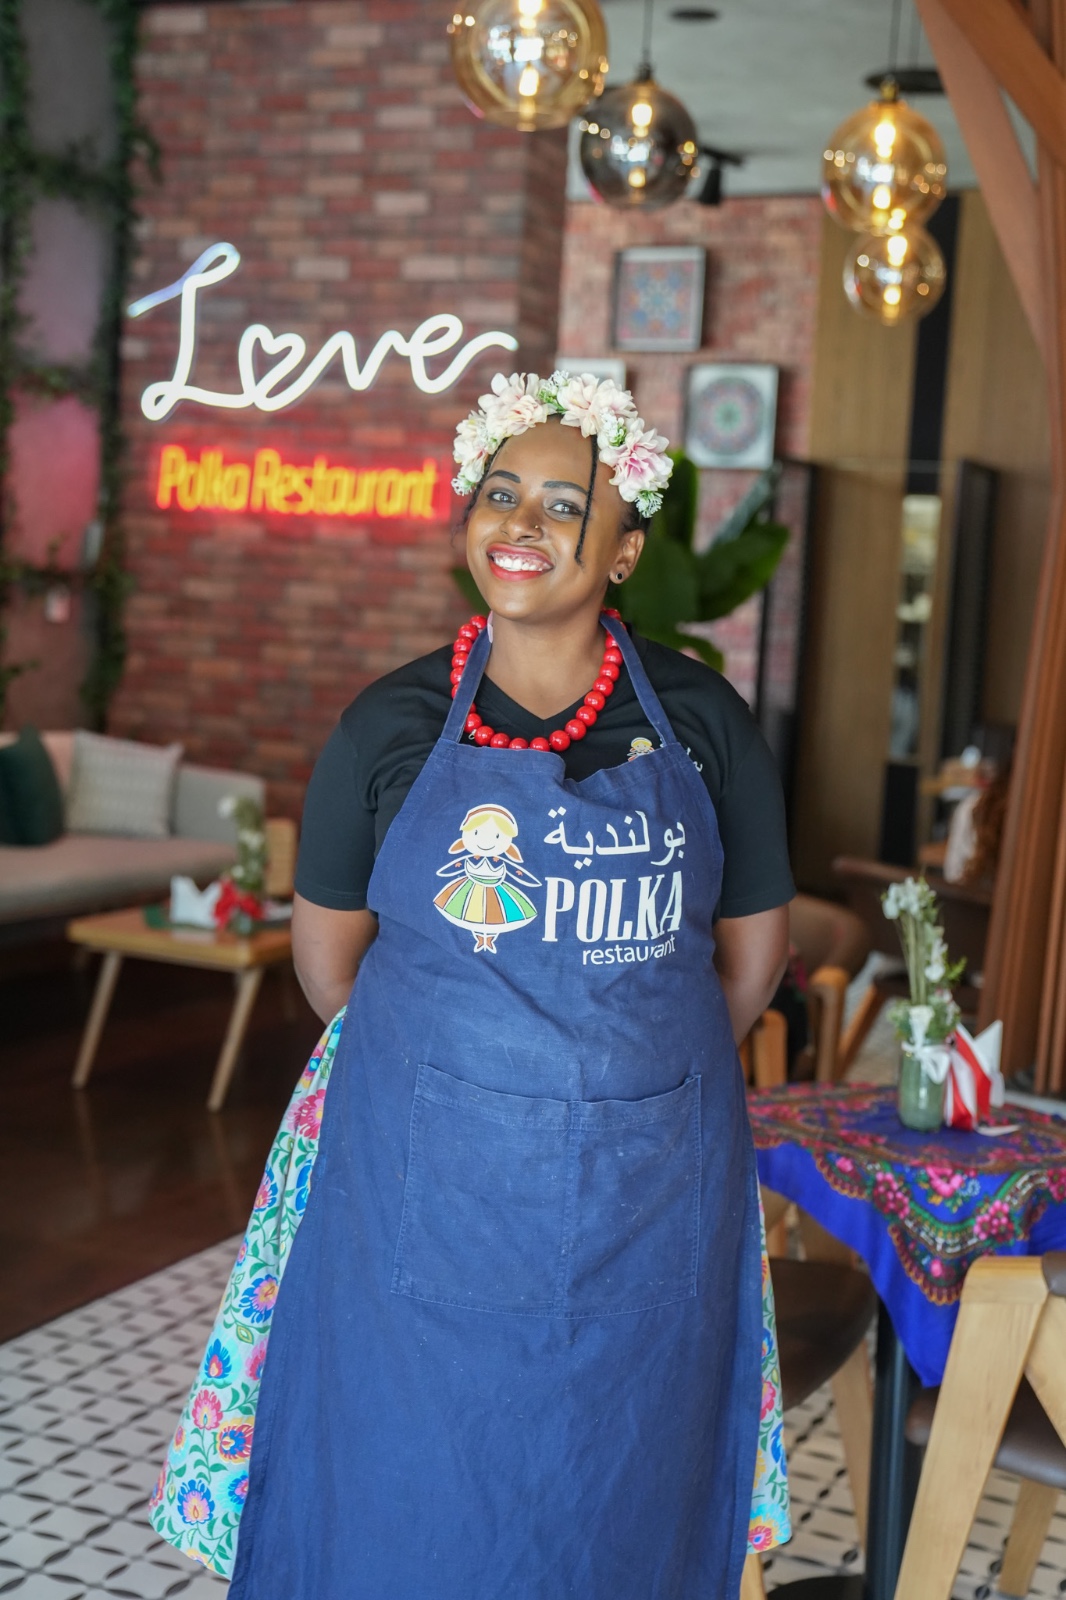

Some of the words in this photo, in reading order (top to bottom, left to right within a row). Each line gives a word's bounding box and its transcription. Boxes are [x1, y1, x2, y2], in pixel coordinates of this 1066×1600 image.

[127, 242, 518, 420] Love
[156, 444, 250, 511] Polka
[250, 448, 436, 519] Restaurant
[541, 870, 682, 943] POLKA
[582, 934, 676, 965] restaurant
